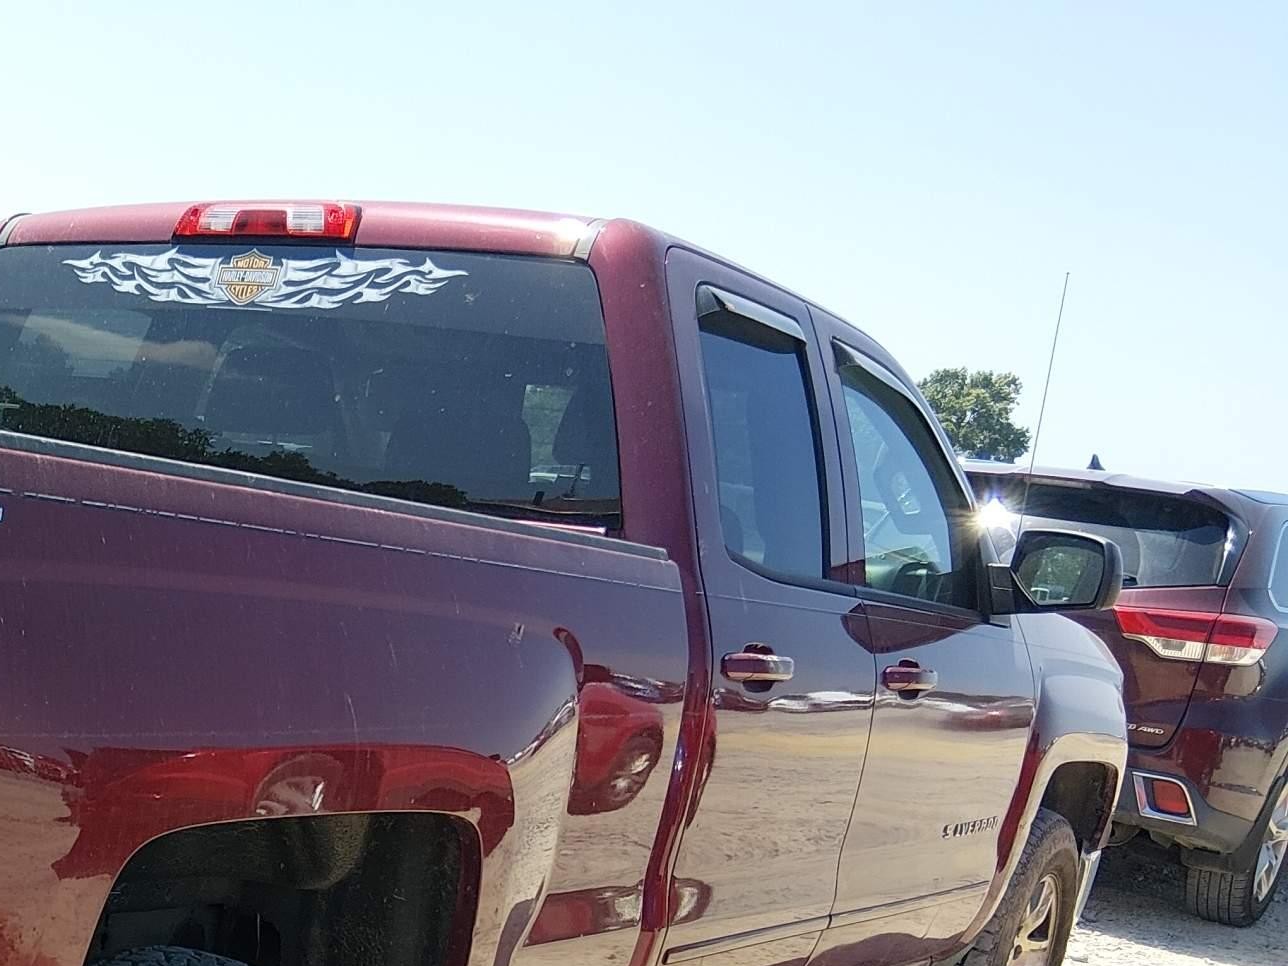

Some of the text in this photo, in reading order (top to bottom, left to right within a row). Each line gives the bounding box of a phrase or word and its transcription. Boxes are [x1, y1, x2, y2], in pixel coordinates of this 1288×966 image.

[234, 256, 268, 268] MOTOR
[222, 271, 274, 283] HARLEY-DAVIDSON
[1136, 726, 1165, 735] AWD
